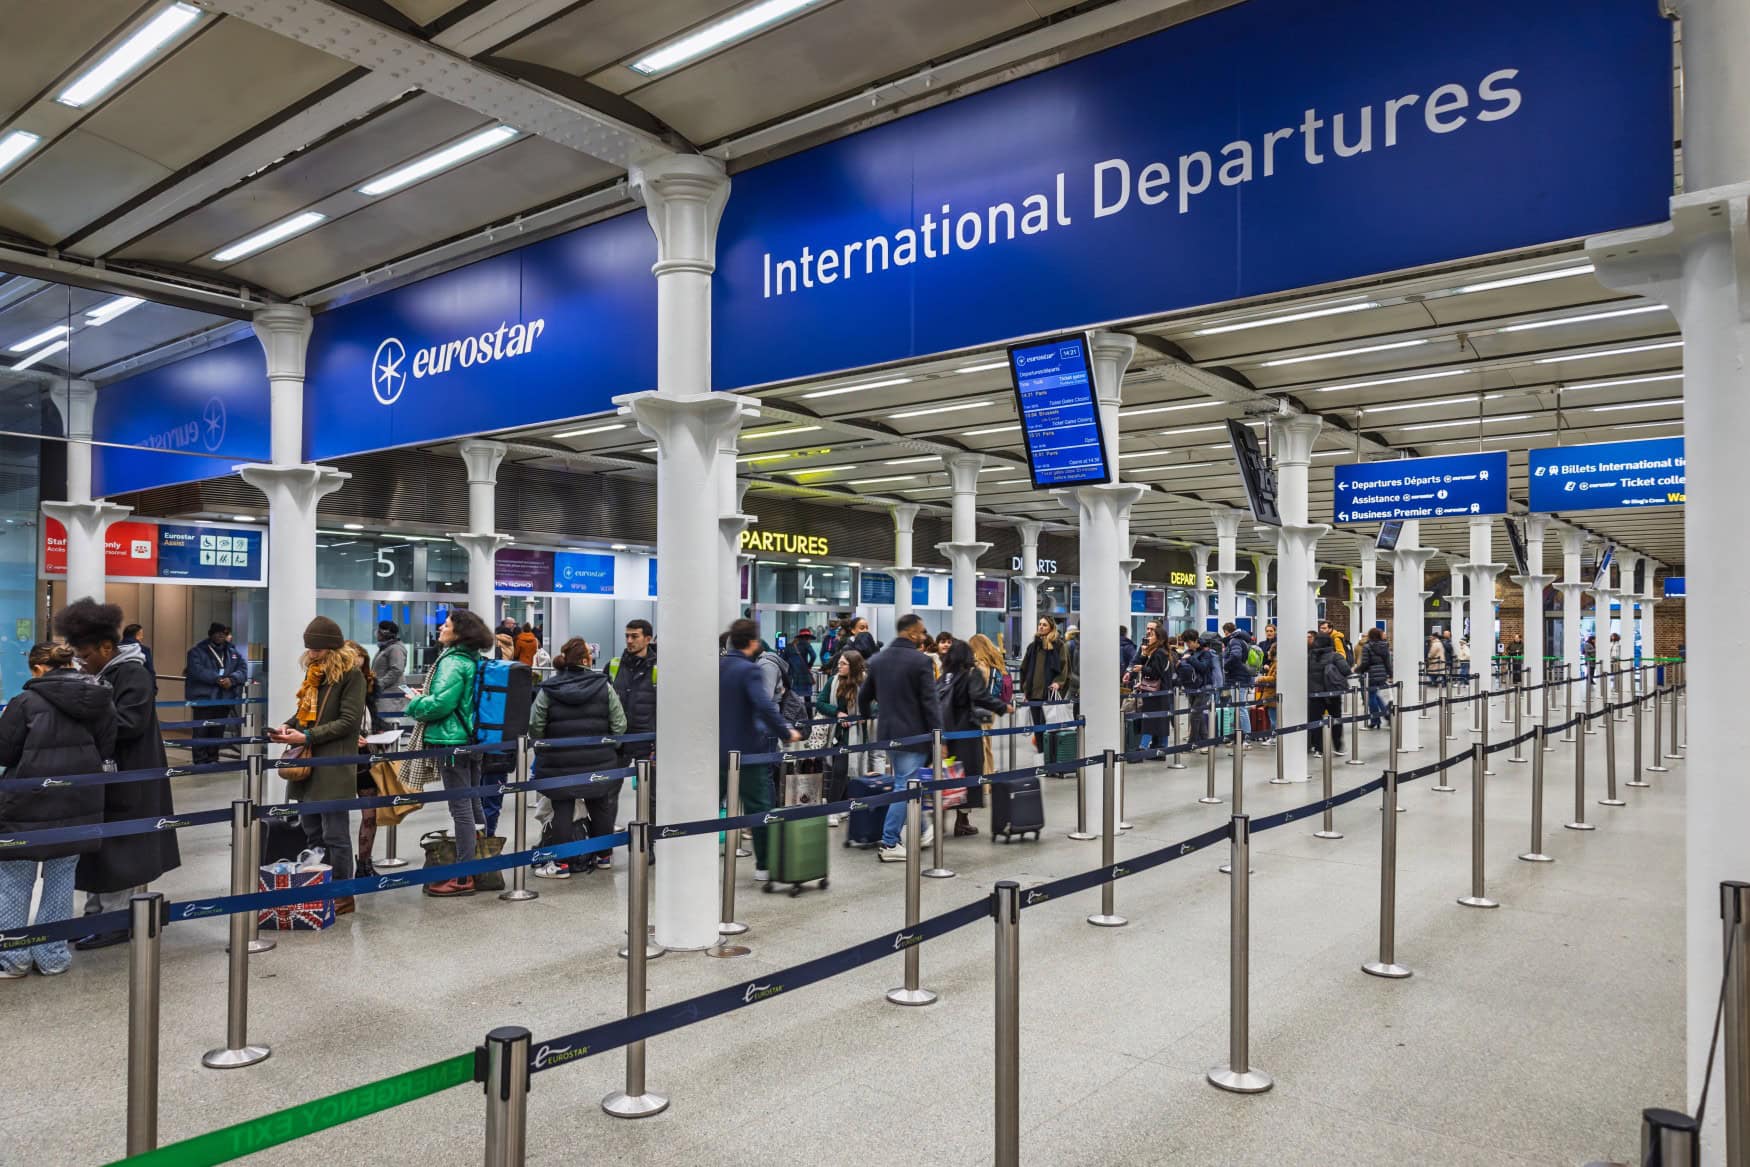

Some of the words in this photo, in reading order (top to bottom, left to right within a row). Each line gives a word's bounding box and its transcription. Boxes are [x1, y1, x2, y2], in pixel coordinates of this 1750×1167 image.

[762, 172, 1071, 298] International
[1093, 67, 1522, 217] Departures
[412, 318, 545, 378] eurostar
[1561, 464, 1597, 475] Billets
[1599, 457, 1673, 472] International
[1351, 478, 1402, 491] Departures
[1403, 475, 1441, 486] Départs
[1620, 477, 1656, 487] Ticket
[1657, 475, 1687, 485] colle
[1352, 494, 1400, 505] Assistance
[1667, 492, 1687, 502] Wa
[1352, 510, 1392, 520] Business
[1393, 507, 1433, 518] Premier
[47, 537, 67, 545] Staf
[164, 532, 196, 541] Eurostar
[740, 530, 829, 556] PARTURES
[376, 548, 395, 578] 5
[1012, 556, 1057, 574] DRTS
[803, 573, 815, 596] 4
[1170, 571, 1214, 588] DEPARTES
[547, 1046, 588, 1065] EUROSTAR
